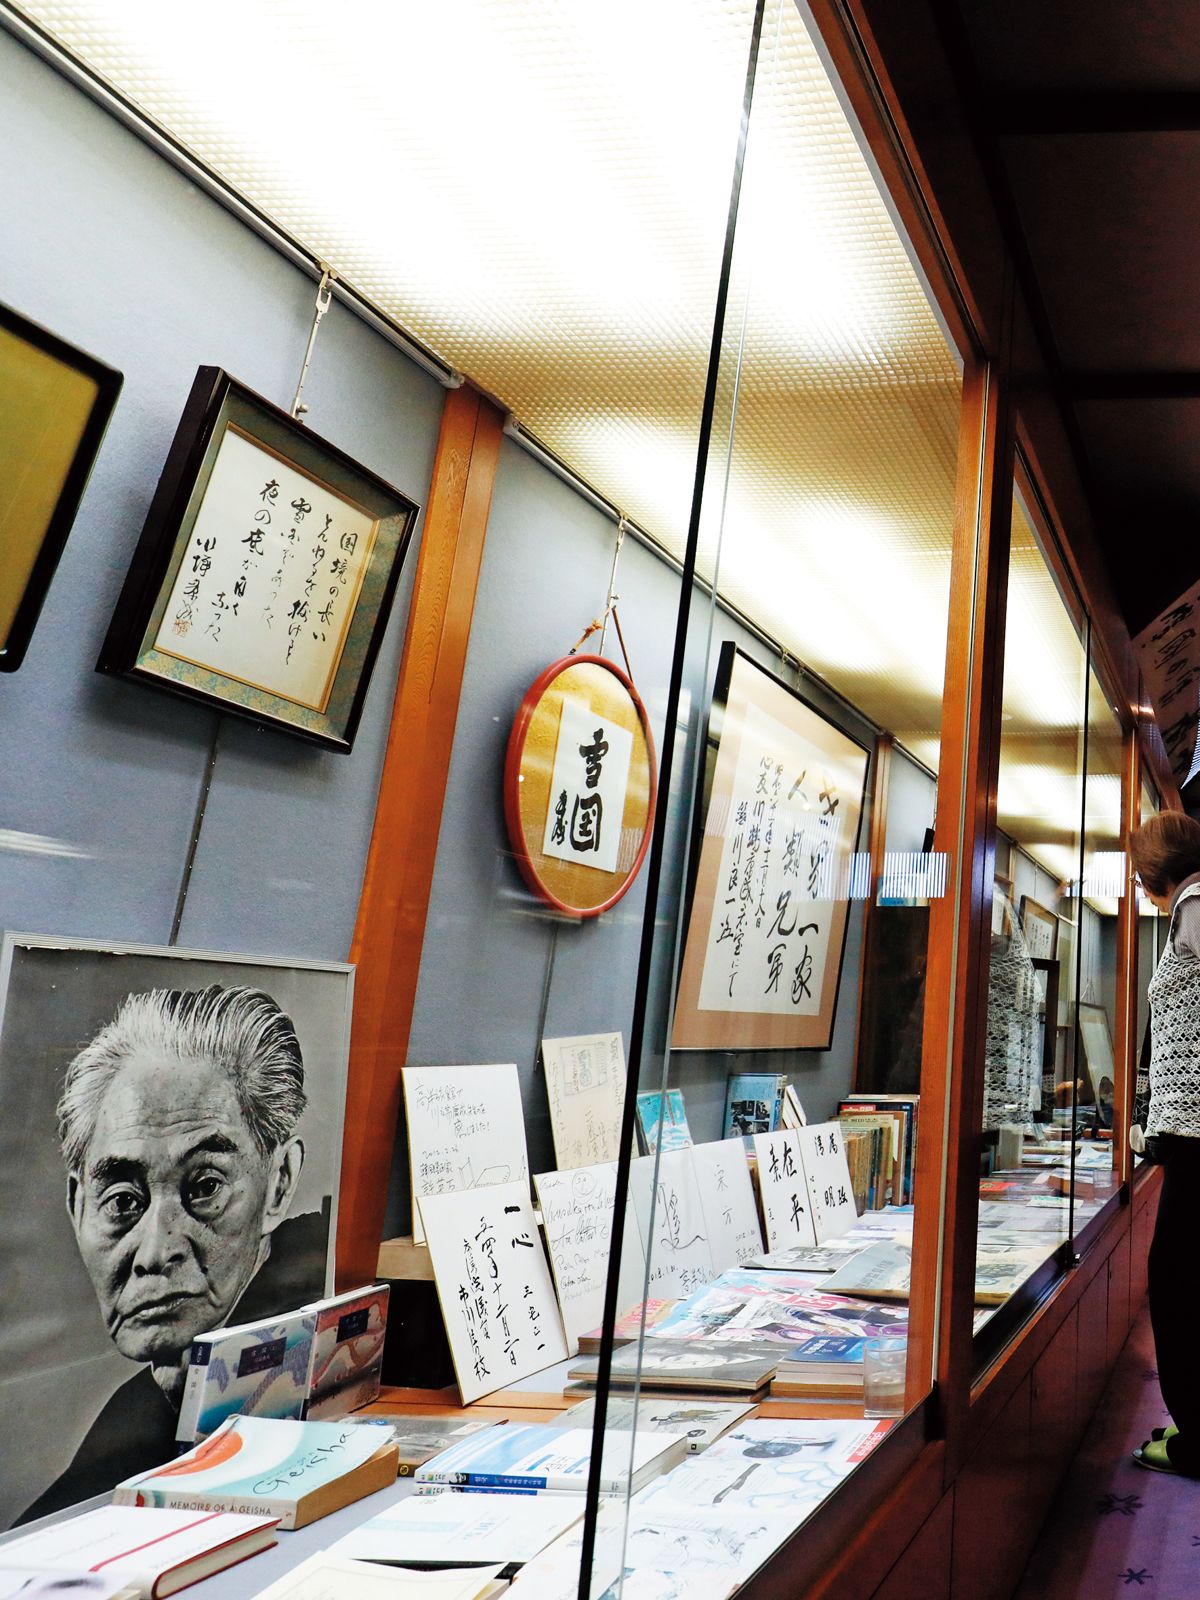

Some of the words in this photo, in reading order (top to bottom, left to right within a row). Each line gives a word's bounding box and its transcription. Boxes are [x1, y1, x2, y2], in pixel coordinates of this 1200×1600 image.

[170, 1502, 211, 1513] MEMOIRS
[214, 1504, 225, 1513] OF
[230, 1504, 237, 1513] A
[239, 1506, 273, 1516] GEISHA
